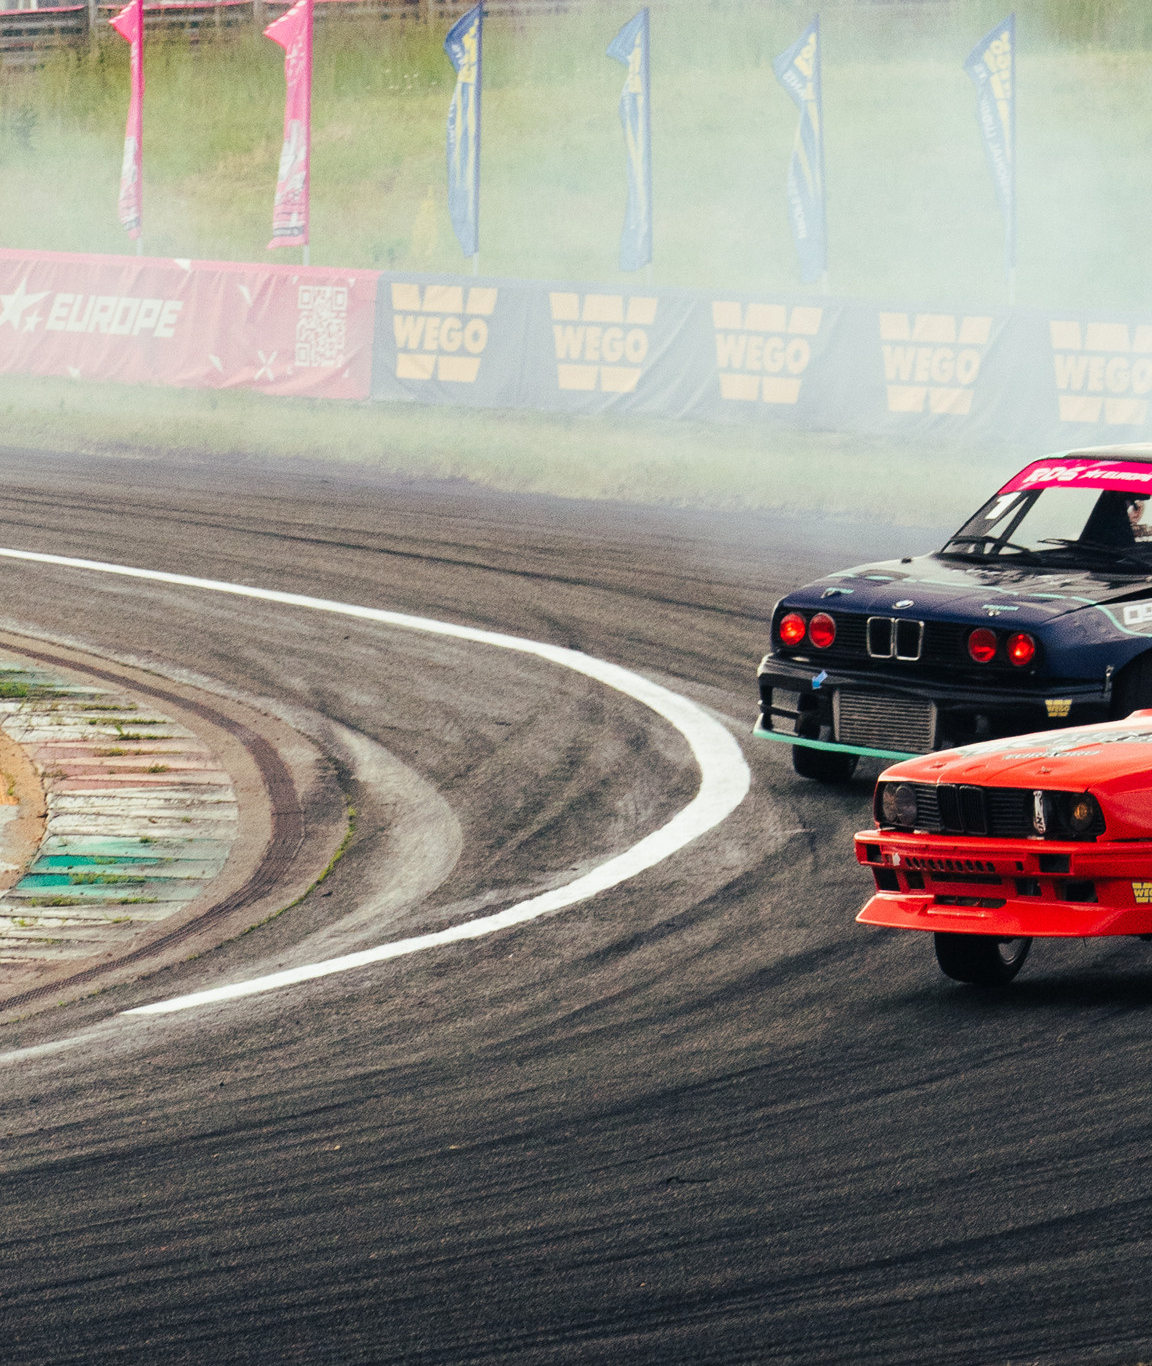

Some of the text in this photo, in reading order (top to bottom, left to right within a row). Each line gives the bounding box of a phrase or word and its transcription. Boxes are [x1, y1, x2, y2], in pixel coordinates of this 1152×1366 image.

[46, 293, 184, 338] EUROPE
[394, 315, 488, 354] WEGO
[553, 325, 649, 363] WEGO
[715, 334, 810, 374] WEGO
[881, 345, 981, 385] WEGO
[1022, 466, 1087, 483] RDS
[985, 492, 1021, 520] 1
